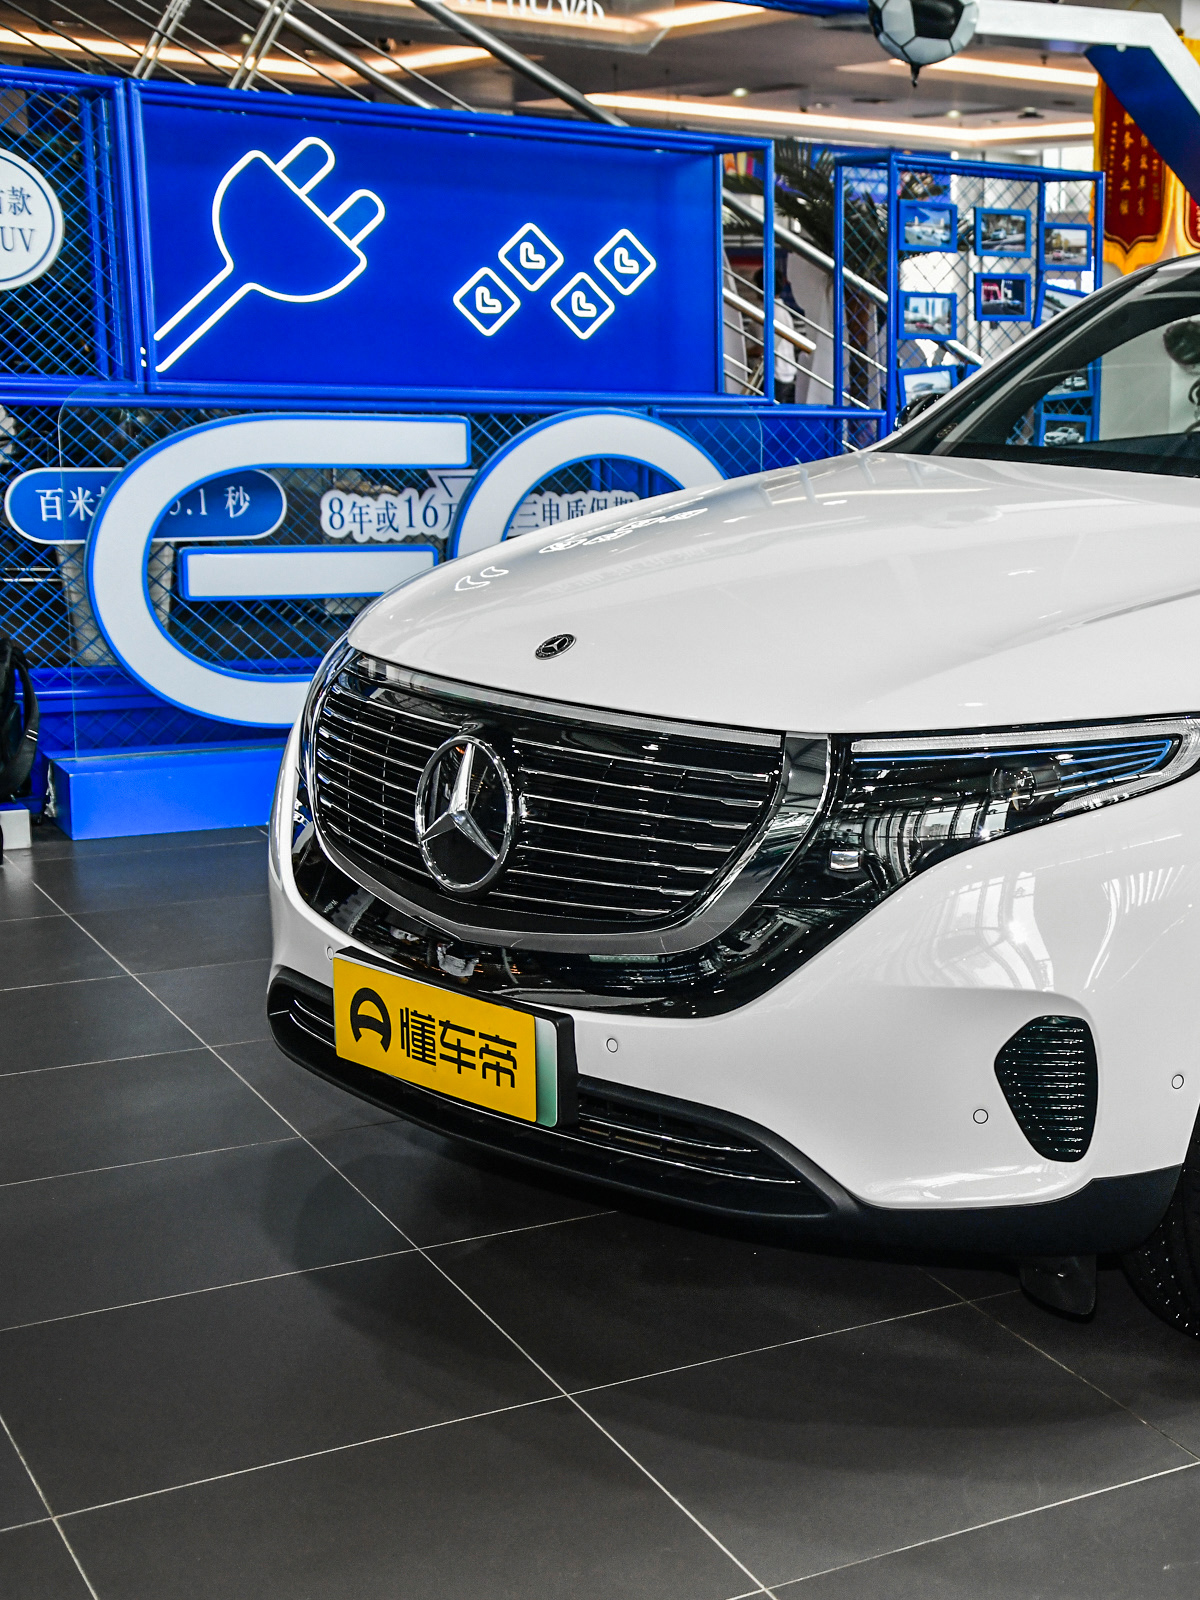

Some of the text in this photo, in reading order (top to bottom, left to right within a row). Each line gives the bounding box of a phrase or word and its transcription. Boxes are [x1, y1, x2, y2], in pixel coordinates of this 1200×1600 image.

[0, 186, 33, 216] 款
[35, 486, 106, 522] 百米
[225, 485, 251, 519] 秒
[400, 1006, 518, 1089] 懂车帝
